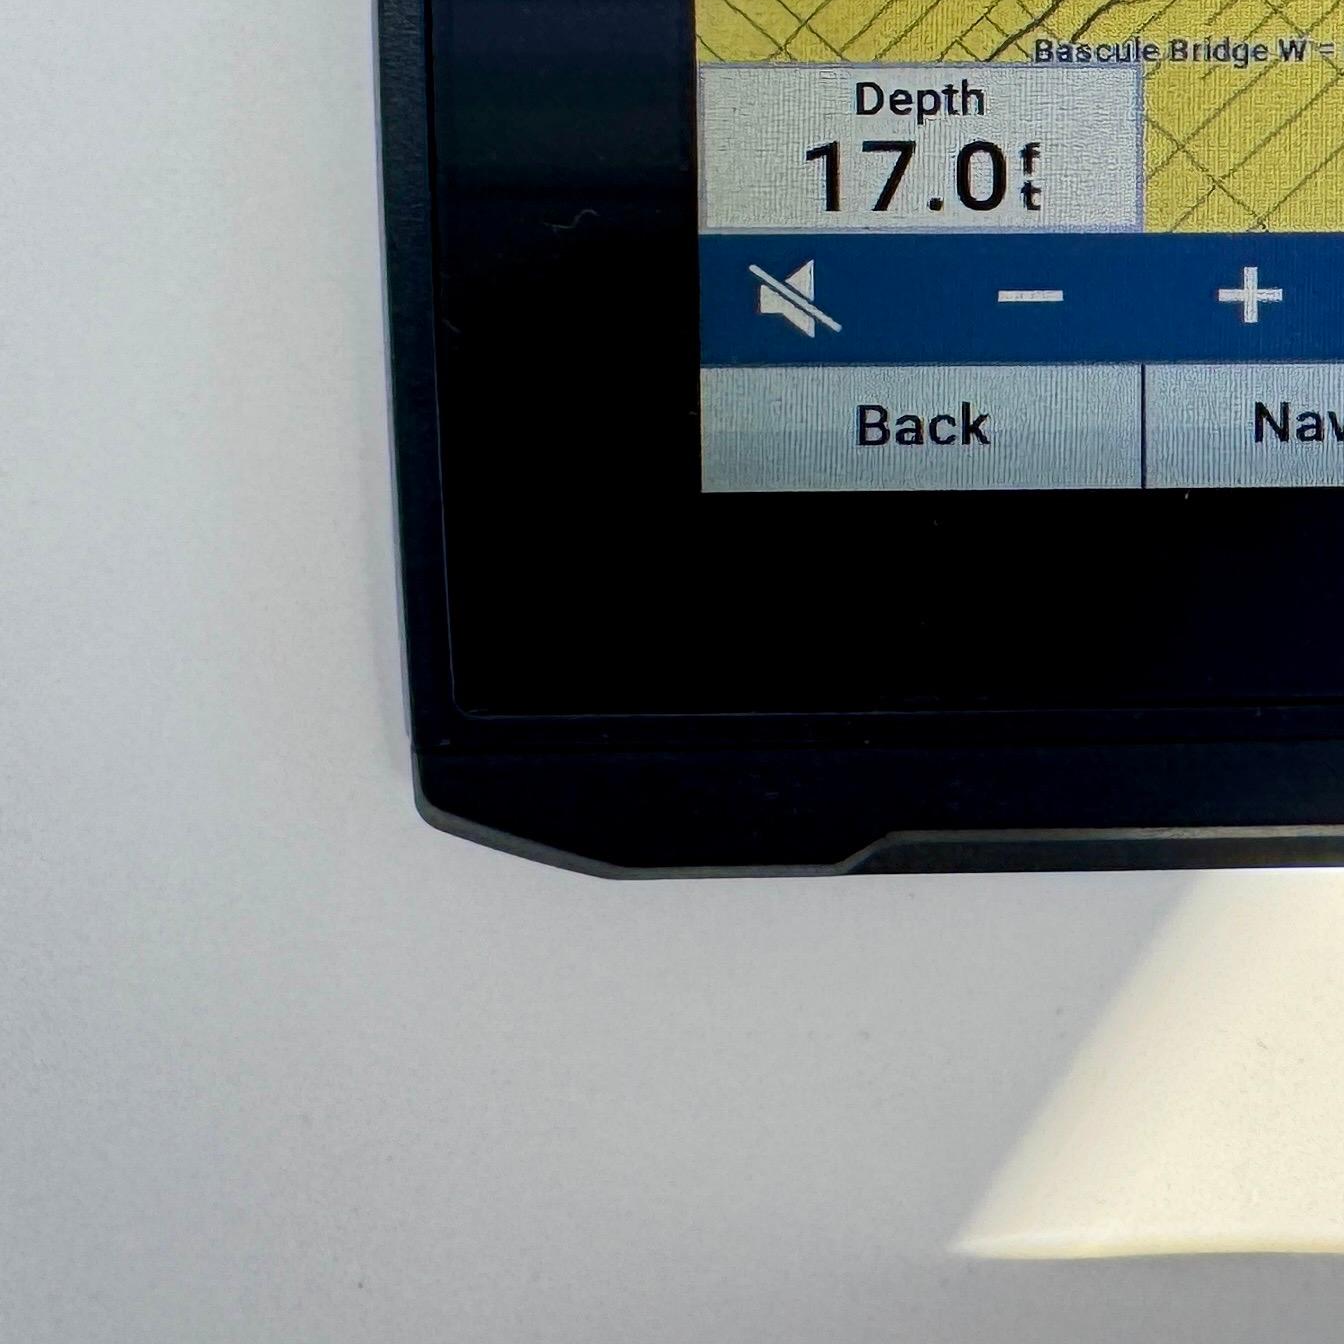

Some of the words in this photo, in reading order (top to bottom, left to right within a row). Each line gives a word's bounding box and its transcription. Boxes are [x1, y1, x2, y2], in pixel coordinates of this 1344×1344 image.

[1034, 38, 1160, 63] Bascule
[1169, 37, 1270, 70] Bridge
[1278, 39, 1308, 63] W
[855, 78, 985, 125] Depth
[805, 140, 1008, 213] 17.0
[856, 401, 992, 447] Back
